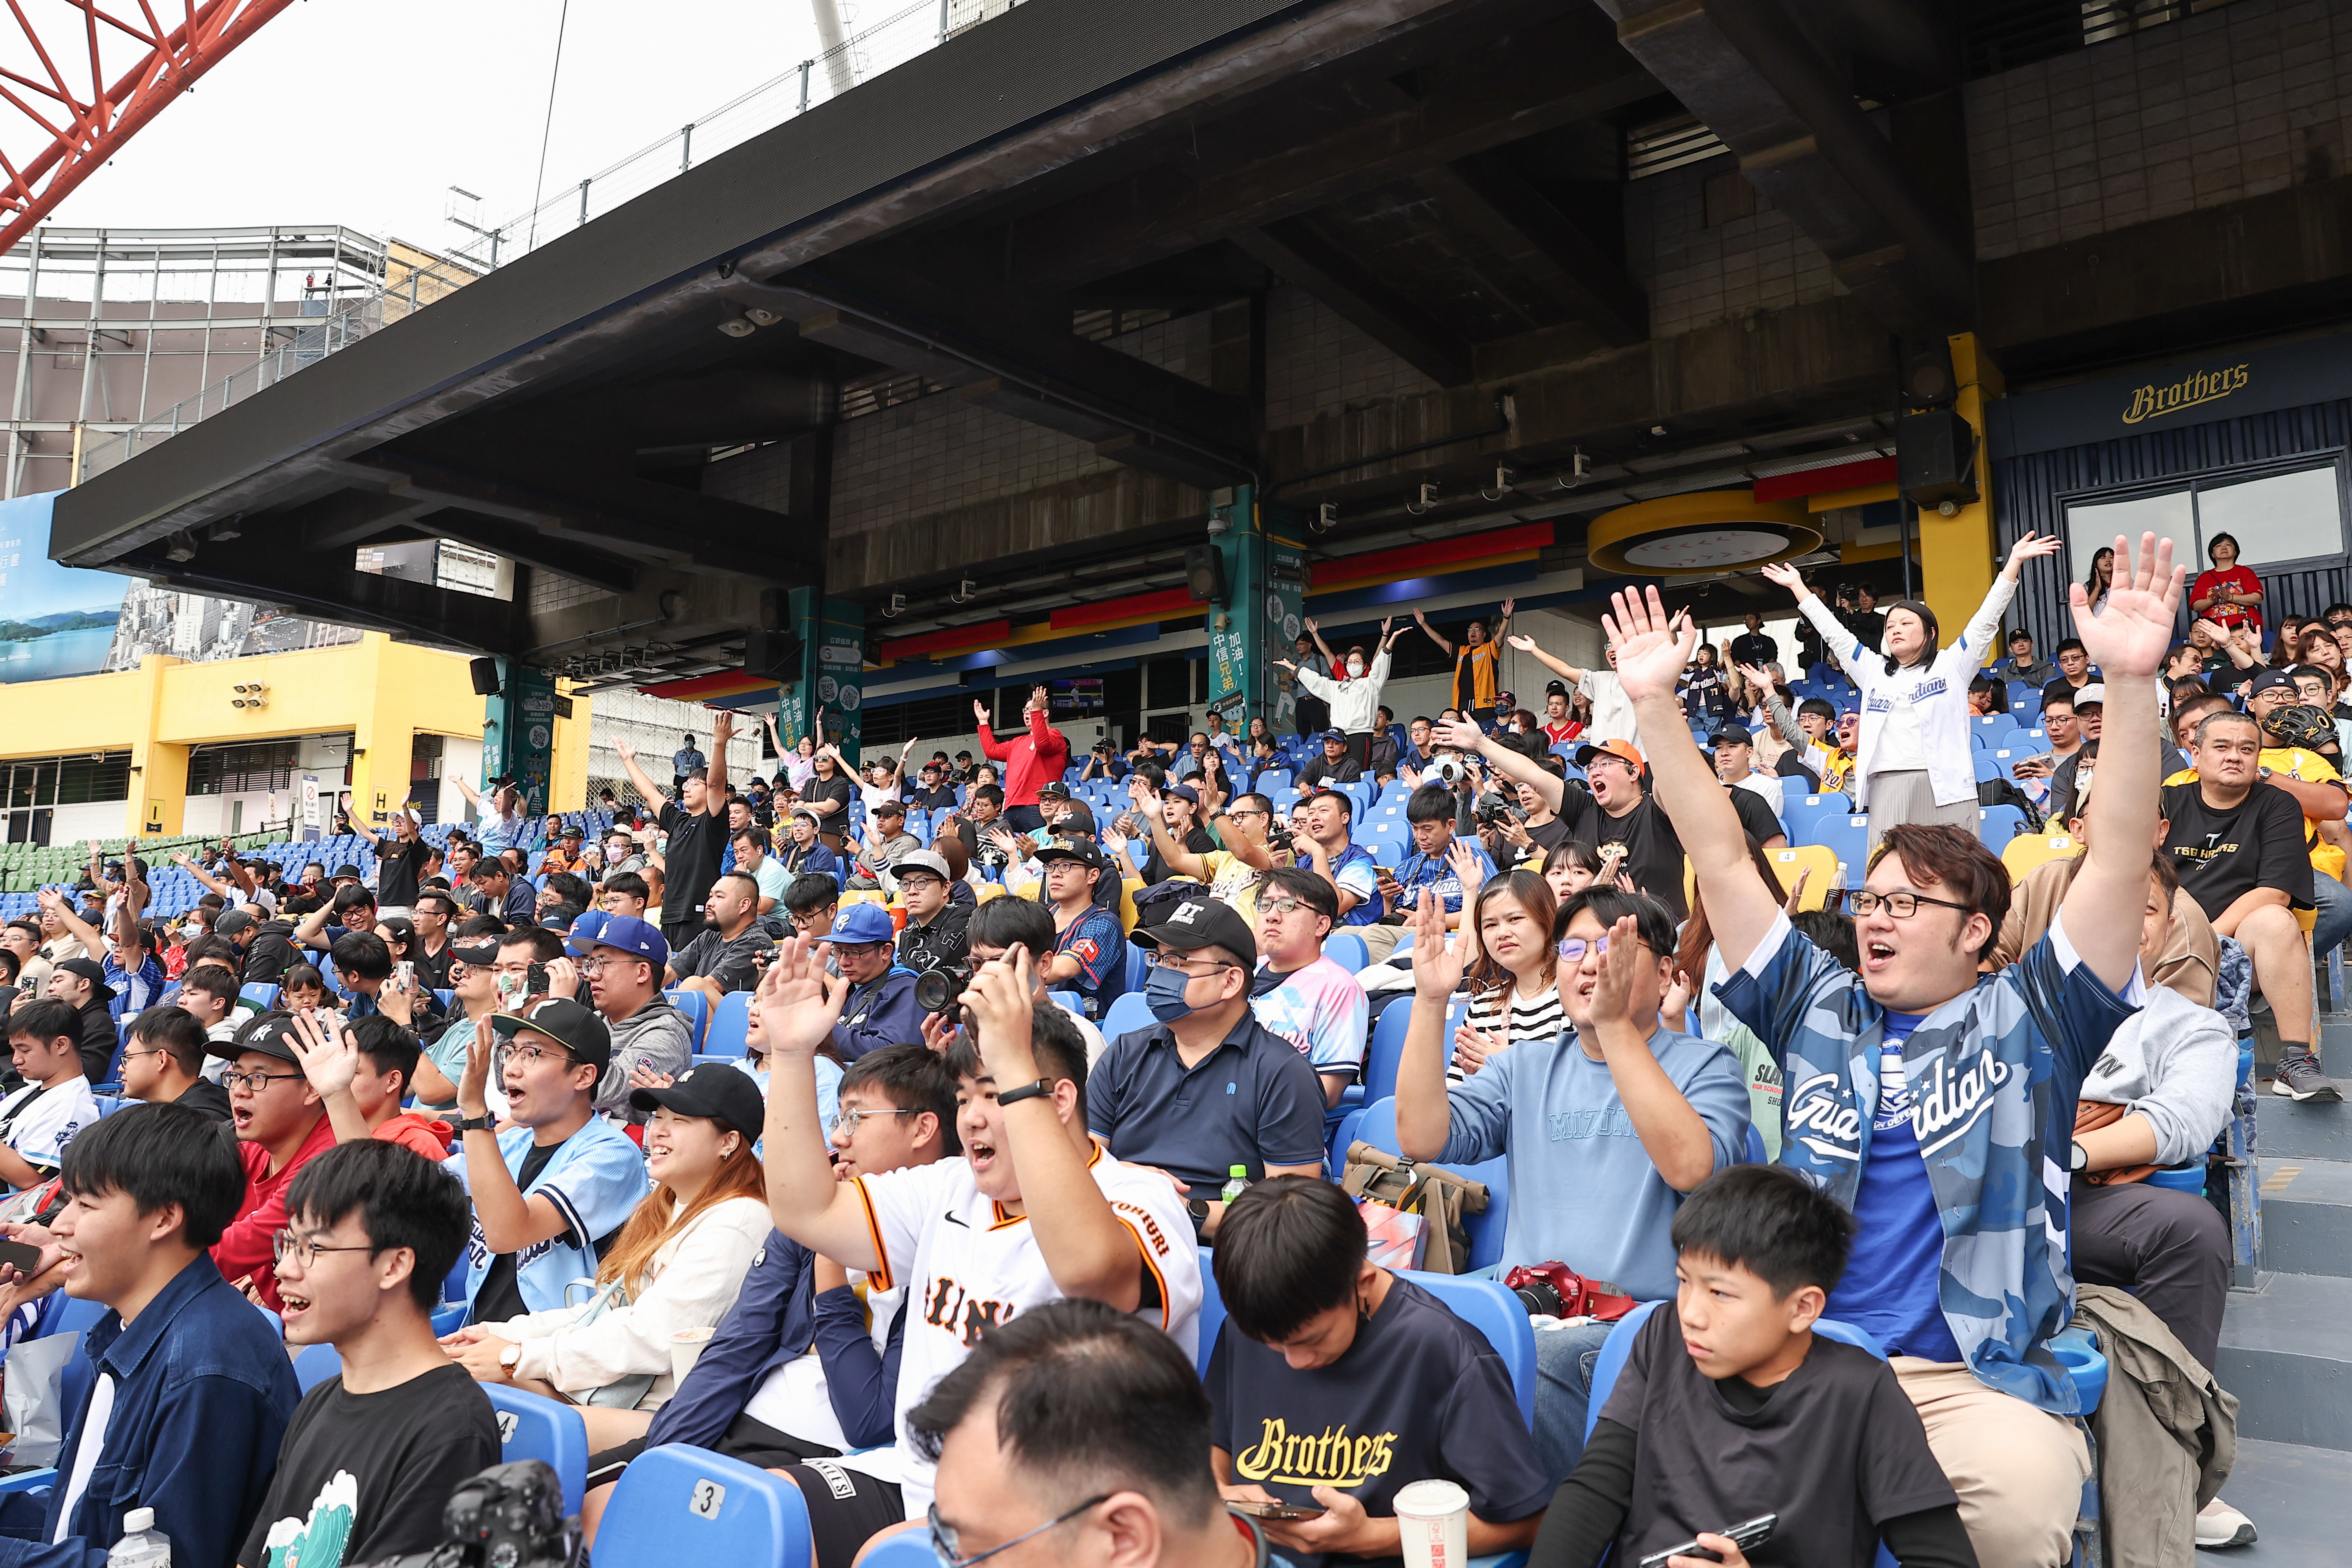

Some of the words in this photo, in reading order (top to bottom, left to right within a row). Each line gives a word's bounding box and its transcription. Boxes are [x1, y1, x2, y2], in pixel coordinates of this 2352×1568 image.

[2122, 363, 2249, 424] Brothers
[1213, 633, 1234, 691] 中信兄弟
[1710, 688, 1718, 696] 77
[556, 699, 562, 711] G
[781, 697, 795, 748] 中信兄弟
[1318, 775, 1337, 788] NIKE
[376, 792, 386, 809] H
[2173, 846, 2198, 857] TSG
[2200, 843, 2240, 859] HAKS
[1763, 1085, 1784, 1095] SCHOO
[1549, 1106, 1639, 1142] MIZUN
[499, 1416, 511, 1434] 4
[700, 1486, 714, 1513] 3
